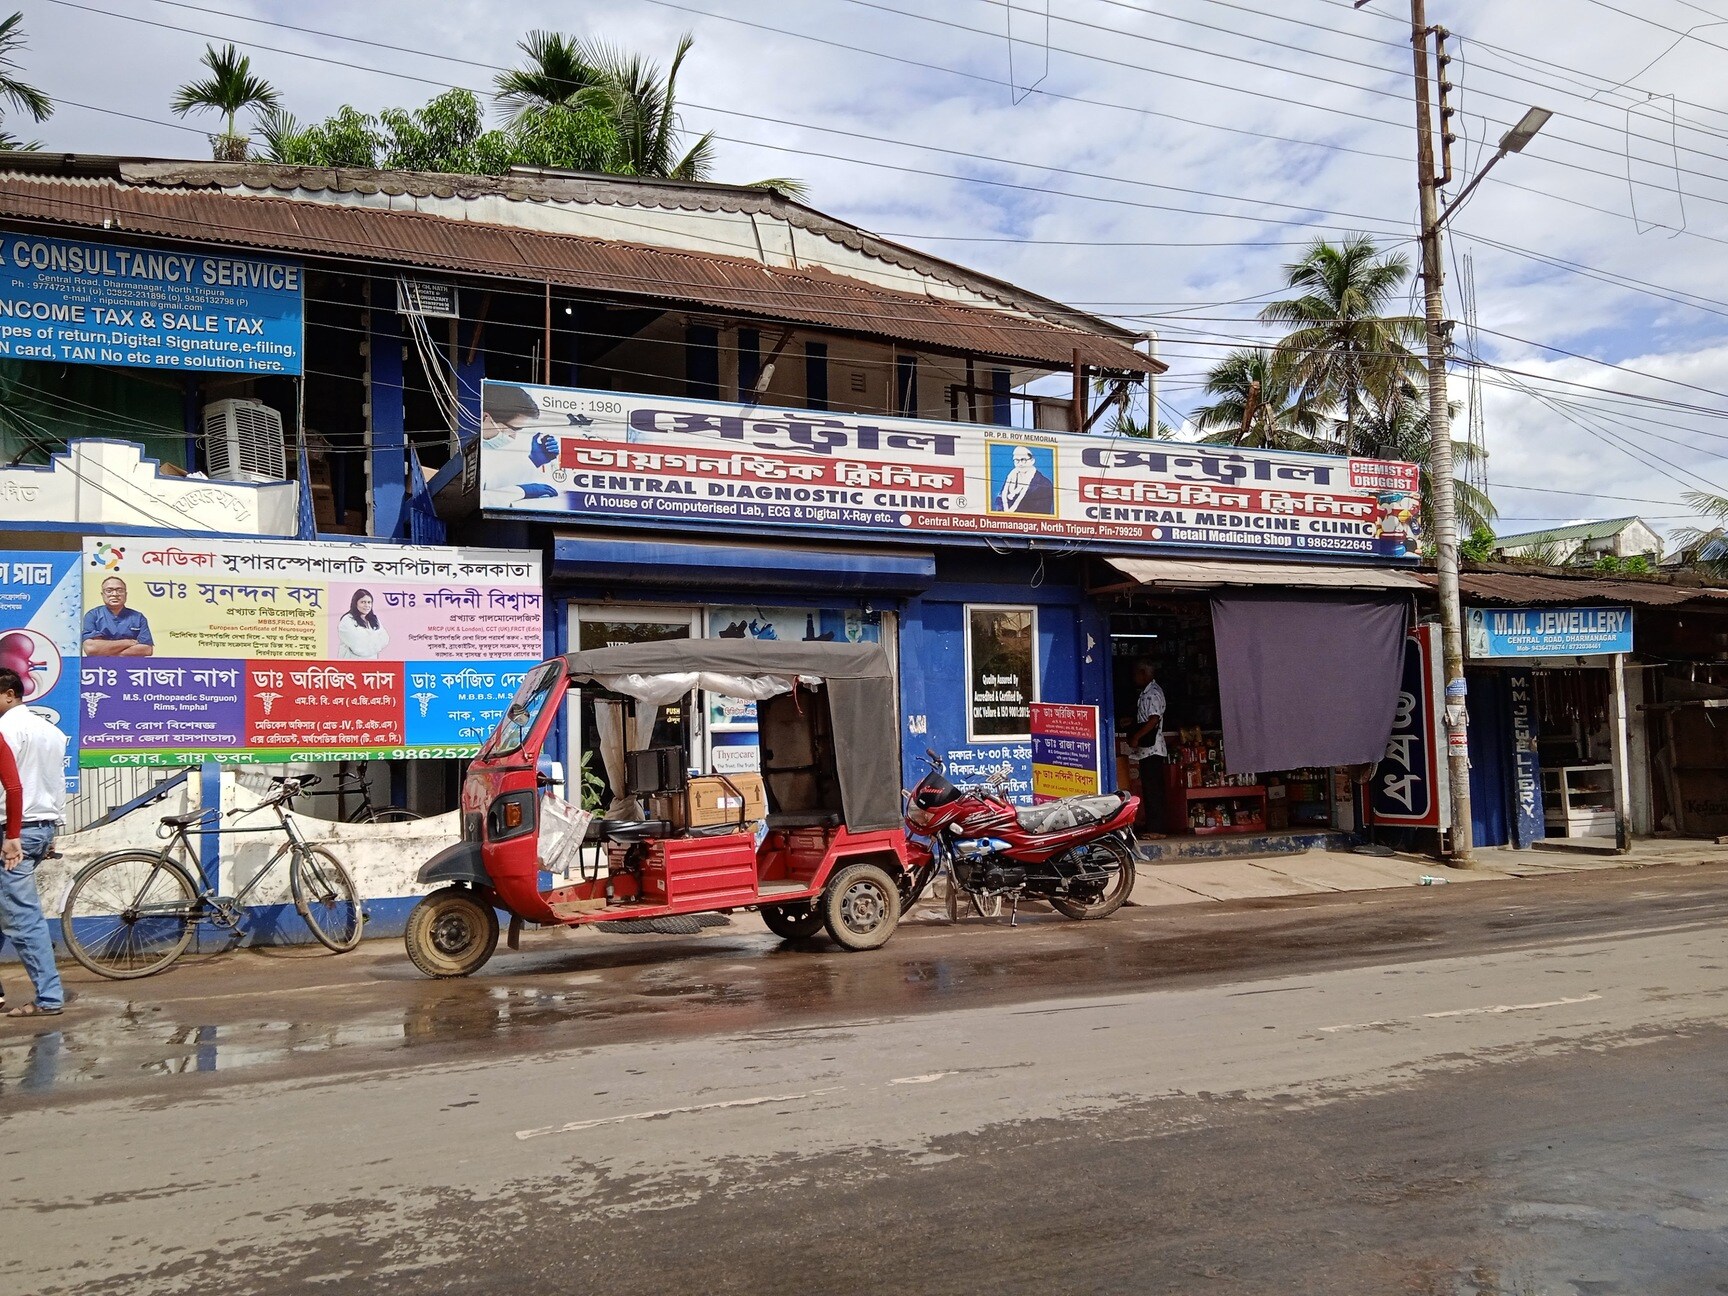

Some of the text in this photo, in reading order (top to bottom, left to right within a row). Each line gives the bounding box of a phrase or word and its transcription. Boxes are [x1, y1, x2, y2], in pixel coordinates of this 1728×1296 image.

[13, 241, 298, 290] CONSULTANCY SERVICE
[11, 279, 24, 288] Ph
[32, 282, 86, 294] 9774721141
[185, 295, 234, 305] 9436132798
[236, 299, 249, 308] (P)
[38, 273, 71, 284] Central
[168, 285, 192, 294] North
[194, 287, 225, 297] Tripura
[63, 294, 203, 311] e-mail nipuchnath@gmail.com
[91, 307, 134, 327] TAX
[140, 311, 156, 328] &
[162, 312, 219, 333] SALE
[224, 317, 264, 335] TAX
[37, 327, 53, 339] of
[15, 345, 56, 359] card,
[61, 346, 95, 360] TAN
[101, 348, 122, 361] No
[127, 351, 151, 363] etc
[155, 354, 179, 365] are
[184, 355, 244, 368] solution
[249, 358, 285, 371] here.
[542, 396, 577, 410] Since
[588, 401, 622, 414] 1980
[631, 409, 961, 456] সেন্ট্রাল
[1024, 435, 1058, 443] MEMORIAL
[833, 461, 955, 489] ক্লিনিক
[1081, 447, 1334, 485] সেন্ট্রাল
[1352, 462, 1414, 477] CHEMIST &
[573, 474, 949, 509] CENTRAL DIAGNOSTIC CLINIC
[1354, 475, 1412, 489] DRUGGIST
[584, 494, 894, 524] (A house of Computerised Lab, ECG & Digital X-Ray etc.
[1084, 482, 1373, 517] মেডিসিন ক্লিনিক
[918, 516, 950, 527] Central
[952, 517, 978, 529] Road,
[980, 518, 1038, 533] Dharmanagar,
[1041, 521, 1064, 532] North
[1099, 525, 1142, 537] Pin-799250
[1085, 506, 1374, 535] CENTRAL MEDICINE CLINIC
[1172, 528, 1372, 550] Retail Medicine Shop 9862522645
[142, 547, 217, 568] মেডিকা
[221, 553, 367, 573] সুপারস্পেশালটি
[143, 580, 324, 609] ডাঃ সুনন্দন বসু
[383, 588, 541, 611] ডাঃ নন্দিনী বিশ্বাস
[1494, 611, 1625, 635] M.M. JEWELLERY
[126, 667, 186, 687] রাজা
[191, 668, 240, 688] নাগ
[252, 666, 395, 689] ডাঃ অরিজিৎ দাস
[411, 672, 436, 689] ডাঃ
[143, 693, 197, 703] (Orthopaedic
[199, 694, 238, 703] Surguon)
[179, 704, 208, 712] Imphal
[665, 707, 681, 715] PUSH
[135, 720, 163, 730] রোগ
[138, 733, 170, 743] জেলা
